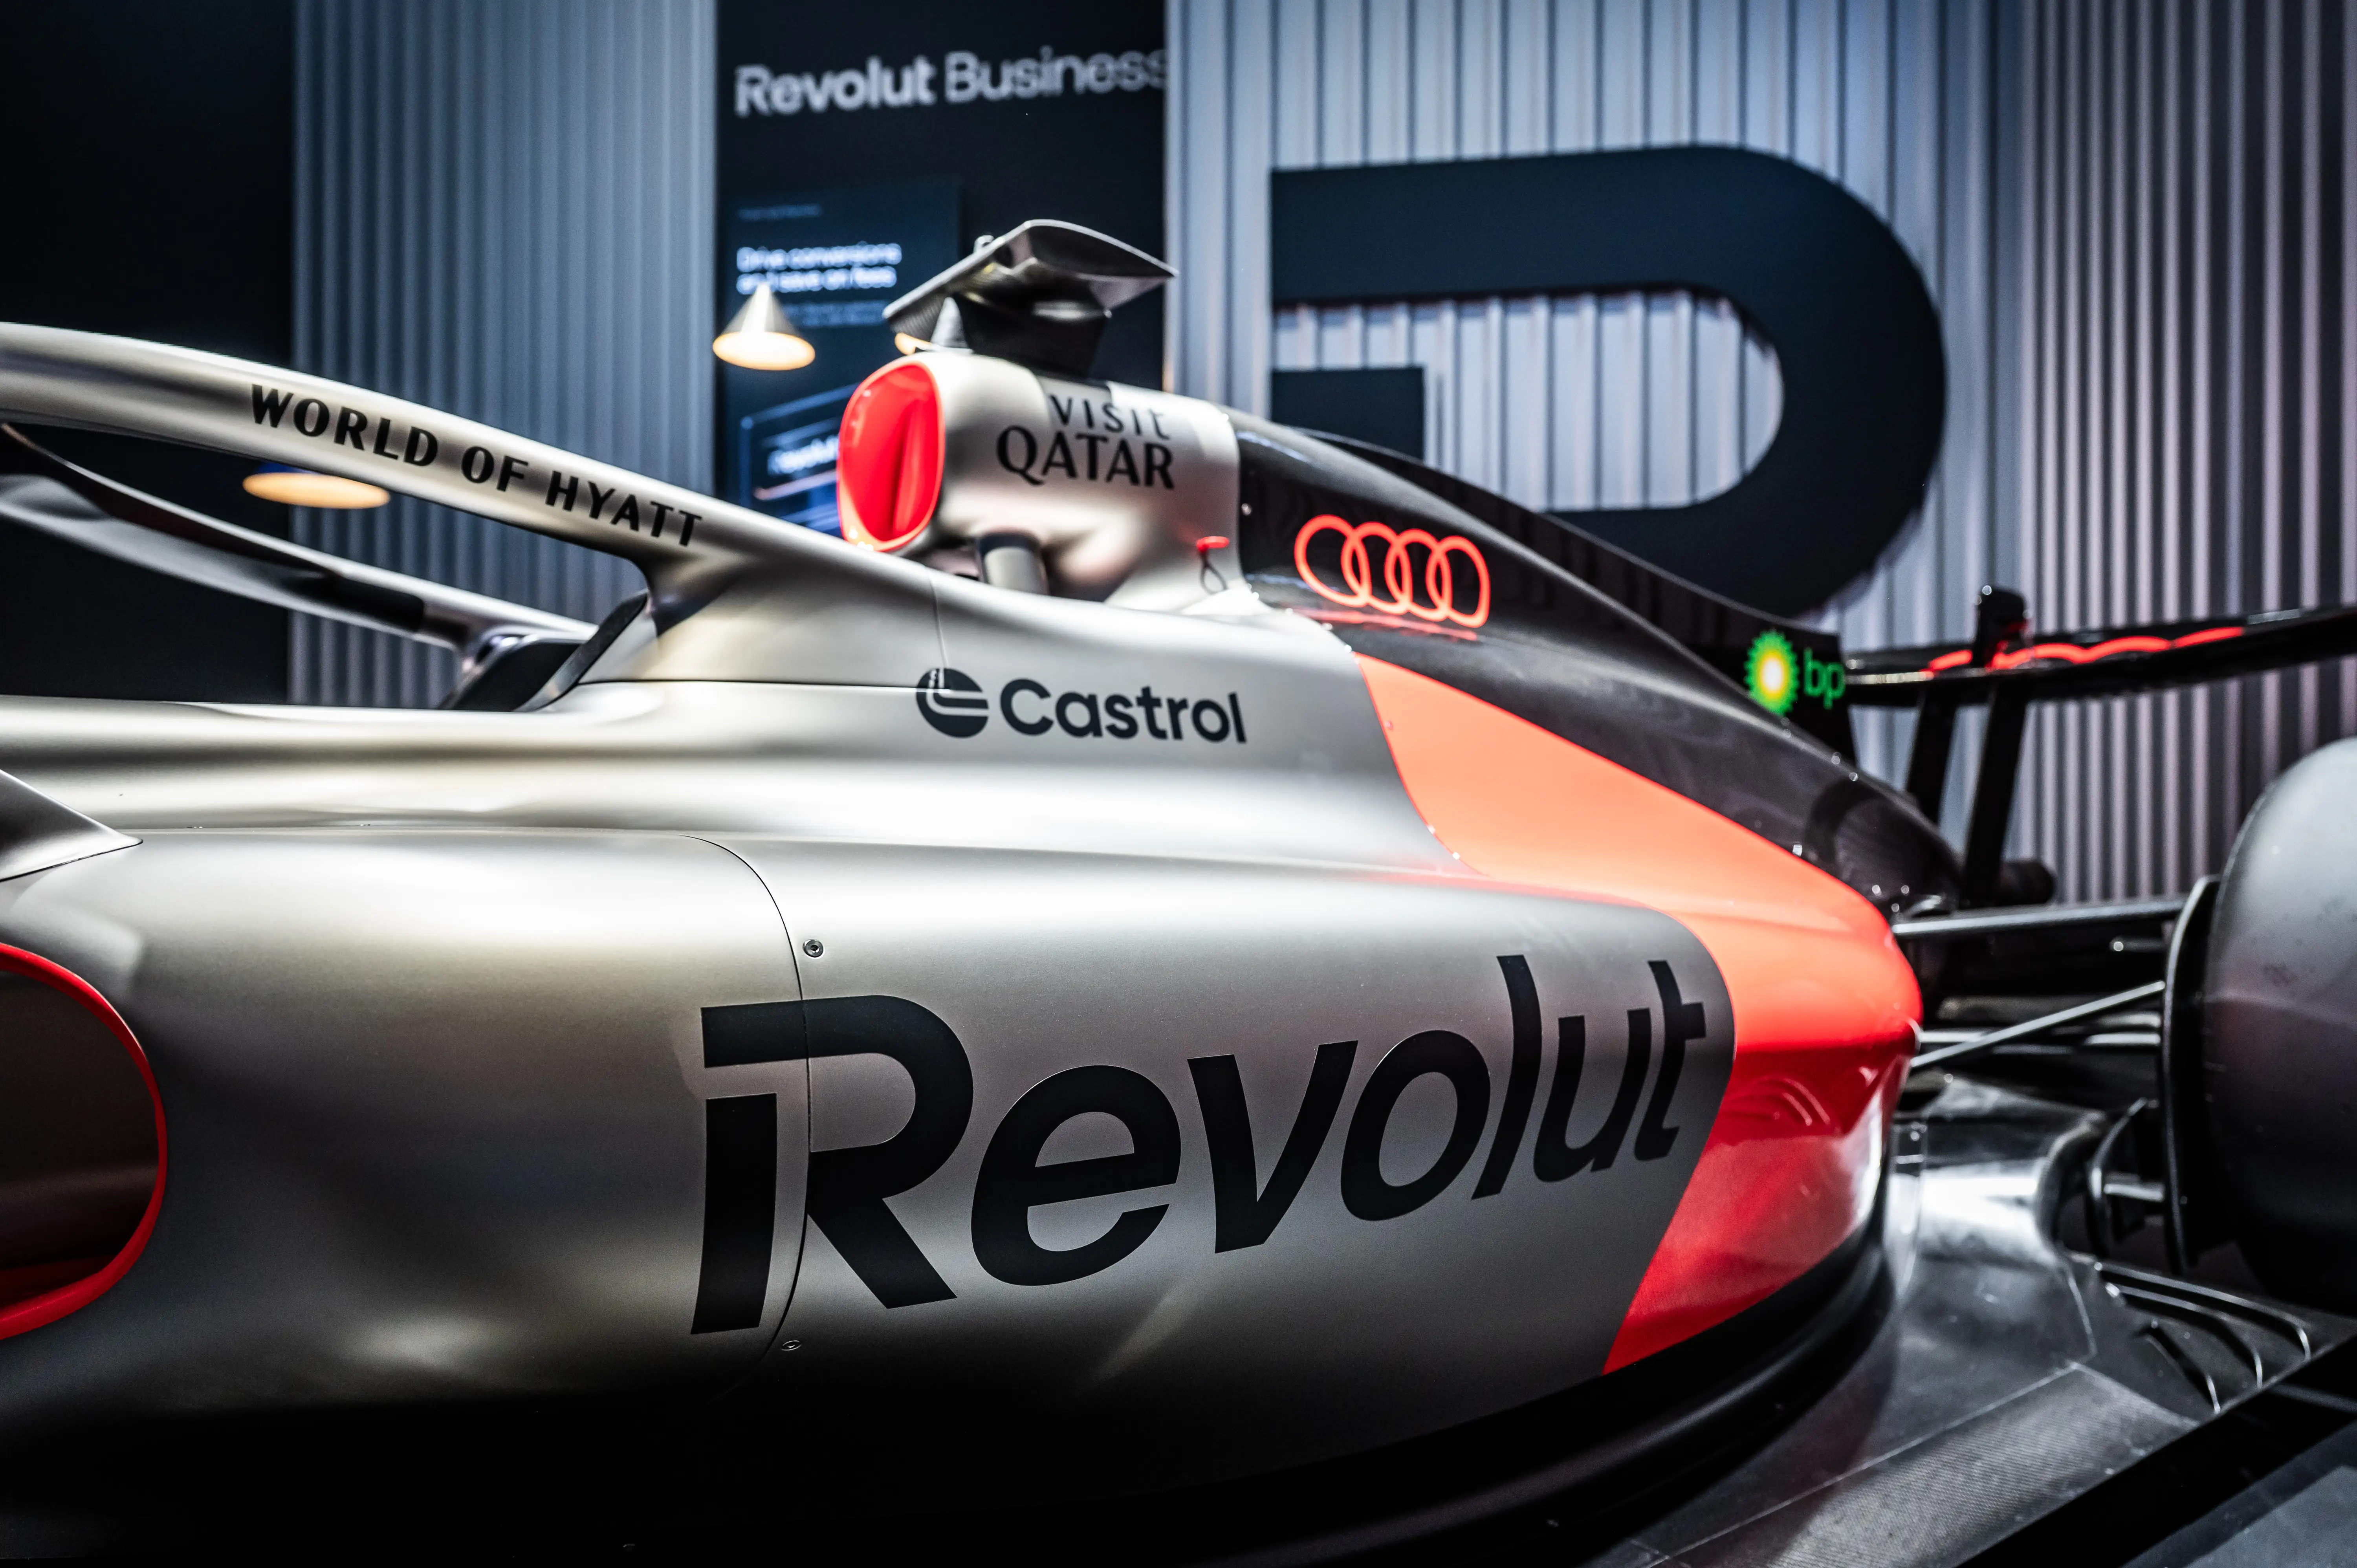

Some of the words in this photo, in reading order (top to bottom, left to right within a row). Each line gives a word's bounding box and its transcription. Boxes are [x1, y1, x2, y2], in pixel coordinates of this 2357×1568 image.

[735, 55, 938, 117] Revolut
[945, 45, 1165, 103] Business
[1050, 394, 1170, 440] VISIT
[251, 384, 438, 467] WORLD
[461, 446, 528, 492] OF
[546, 470, 702, 548] HYATT
[996, 426, 1174, 490] QATAR
[1000, 678, 1247, 744] Castrol
[1804, 647, 1846, 710] bp
[690, 955, 1706, 1335] Revolut
